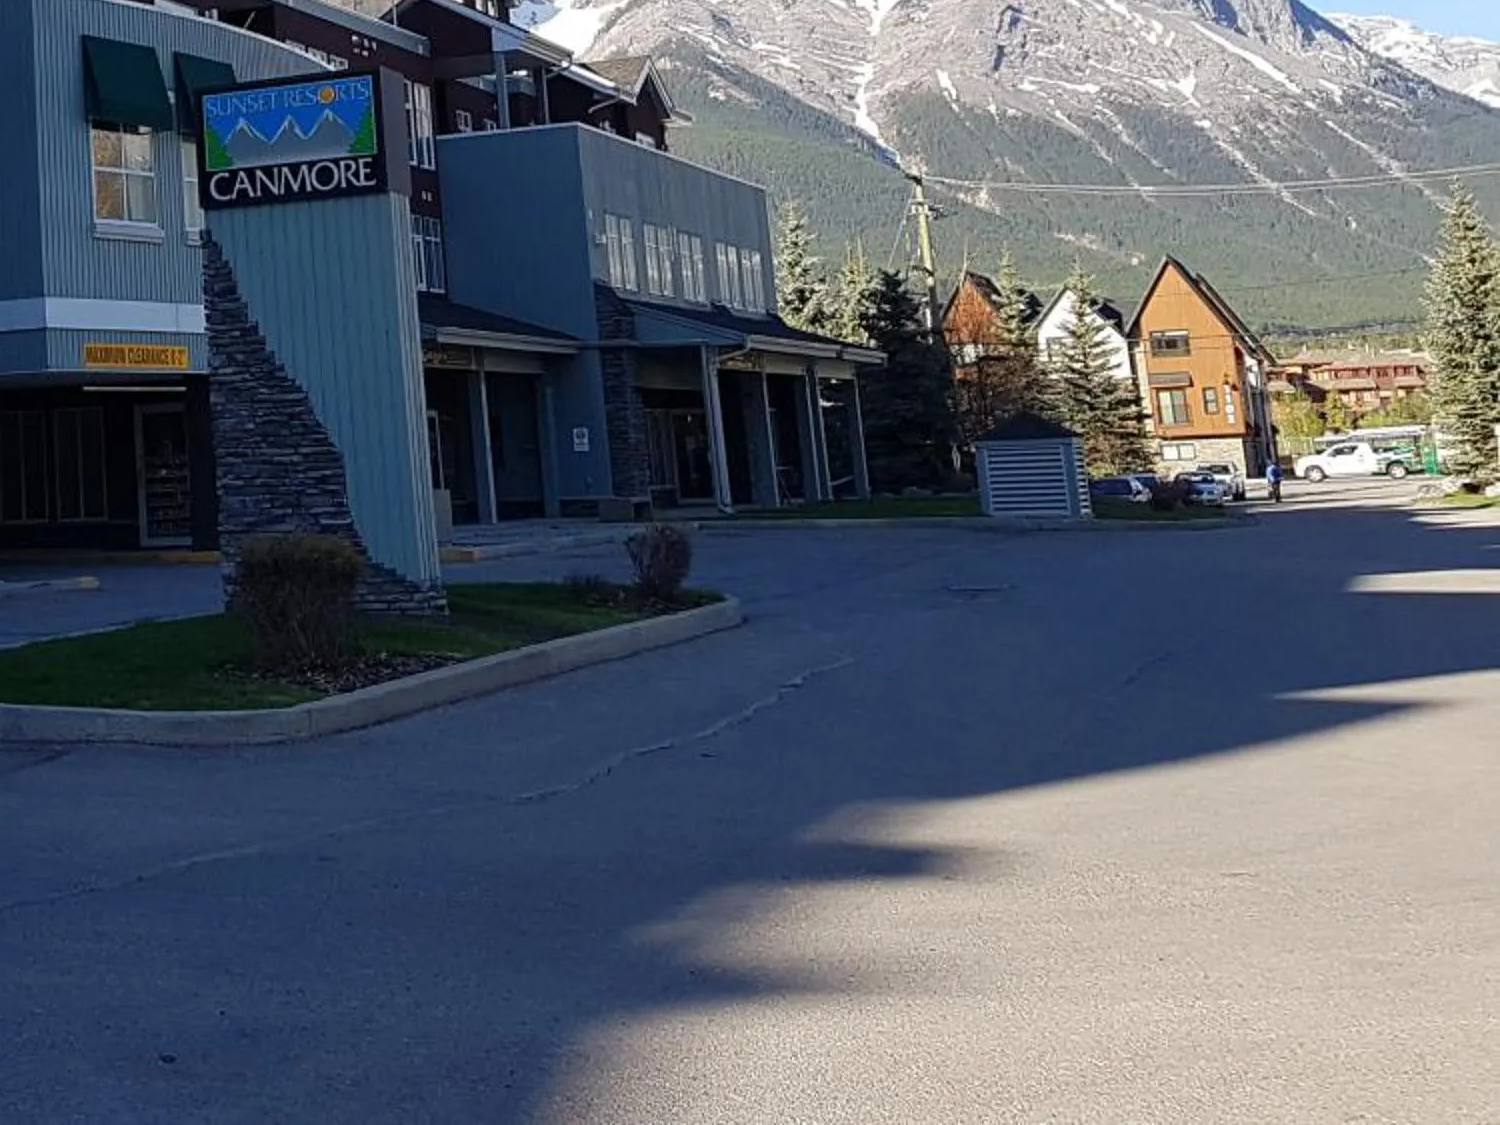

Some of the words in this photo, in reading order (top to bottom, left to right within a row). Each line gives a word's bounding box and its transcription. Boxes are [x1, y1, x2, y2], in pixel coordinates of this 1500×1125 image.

[207, 91, 276, 117] SUNSET
[283, 83, 369, 108] RESORTS
[209, 157, 377, 201] CANMORE
